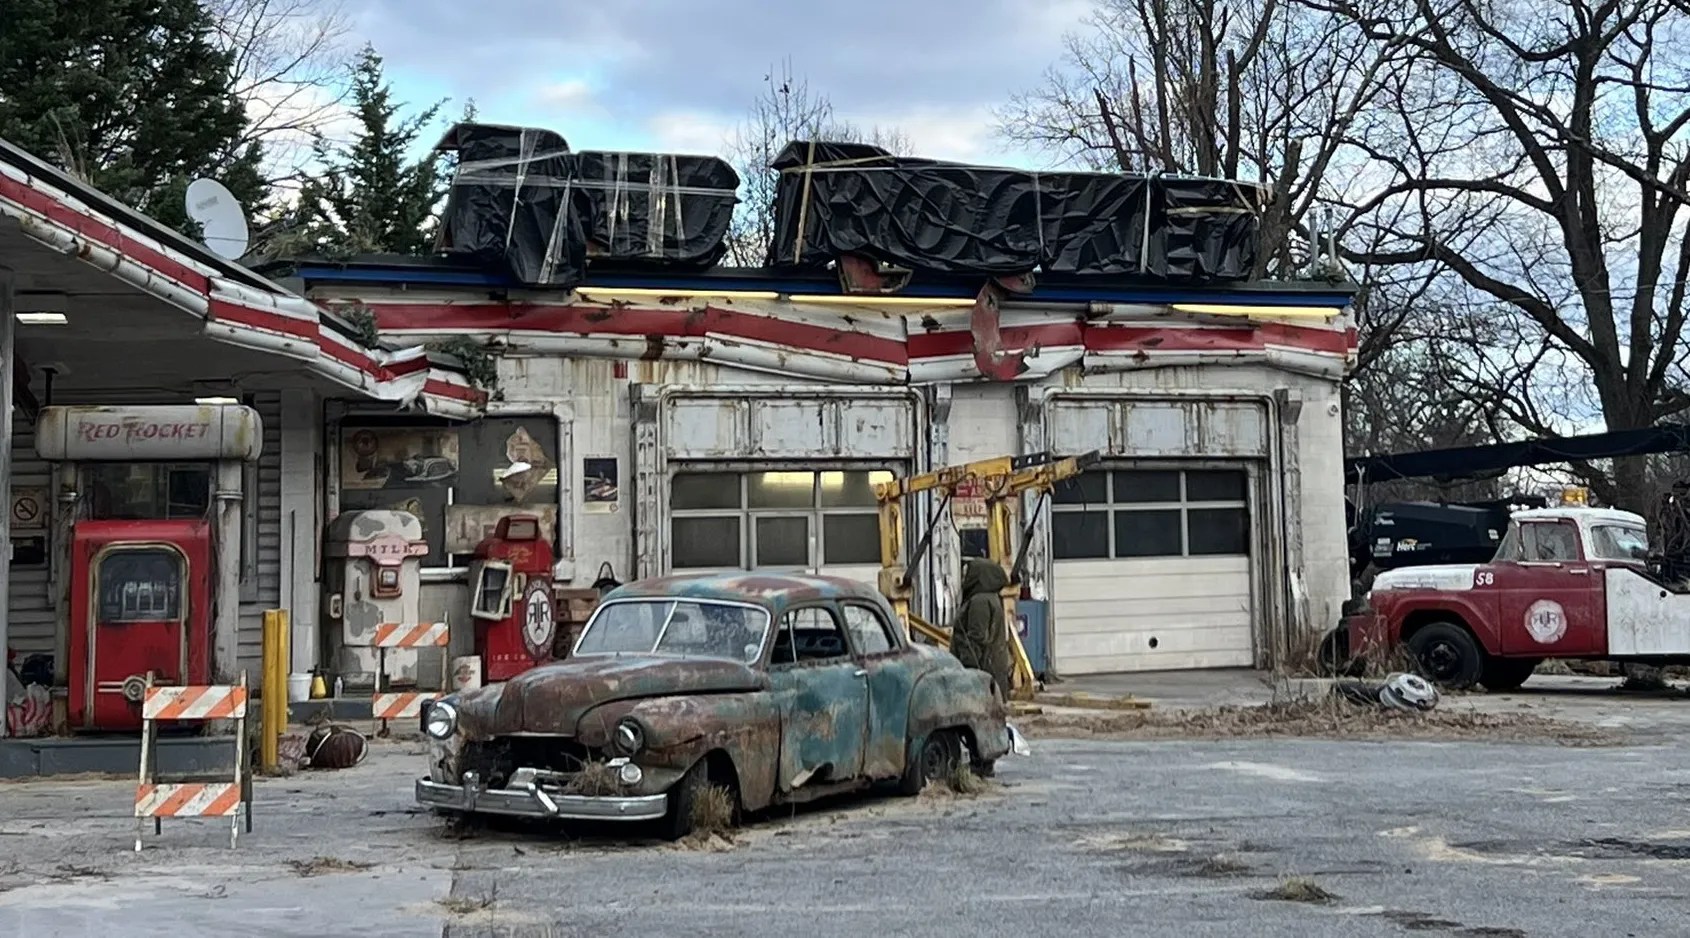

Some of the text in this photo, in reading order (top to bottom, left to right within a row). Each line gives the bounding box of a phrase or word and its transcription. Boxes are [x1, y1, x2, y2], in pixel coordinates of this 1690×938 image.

[78, 421, 210, 442] RED ROCKET
[365, 544, 412, 554] MILK
